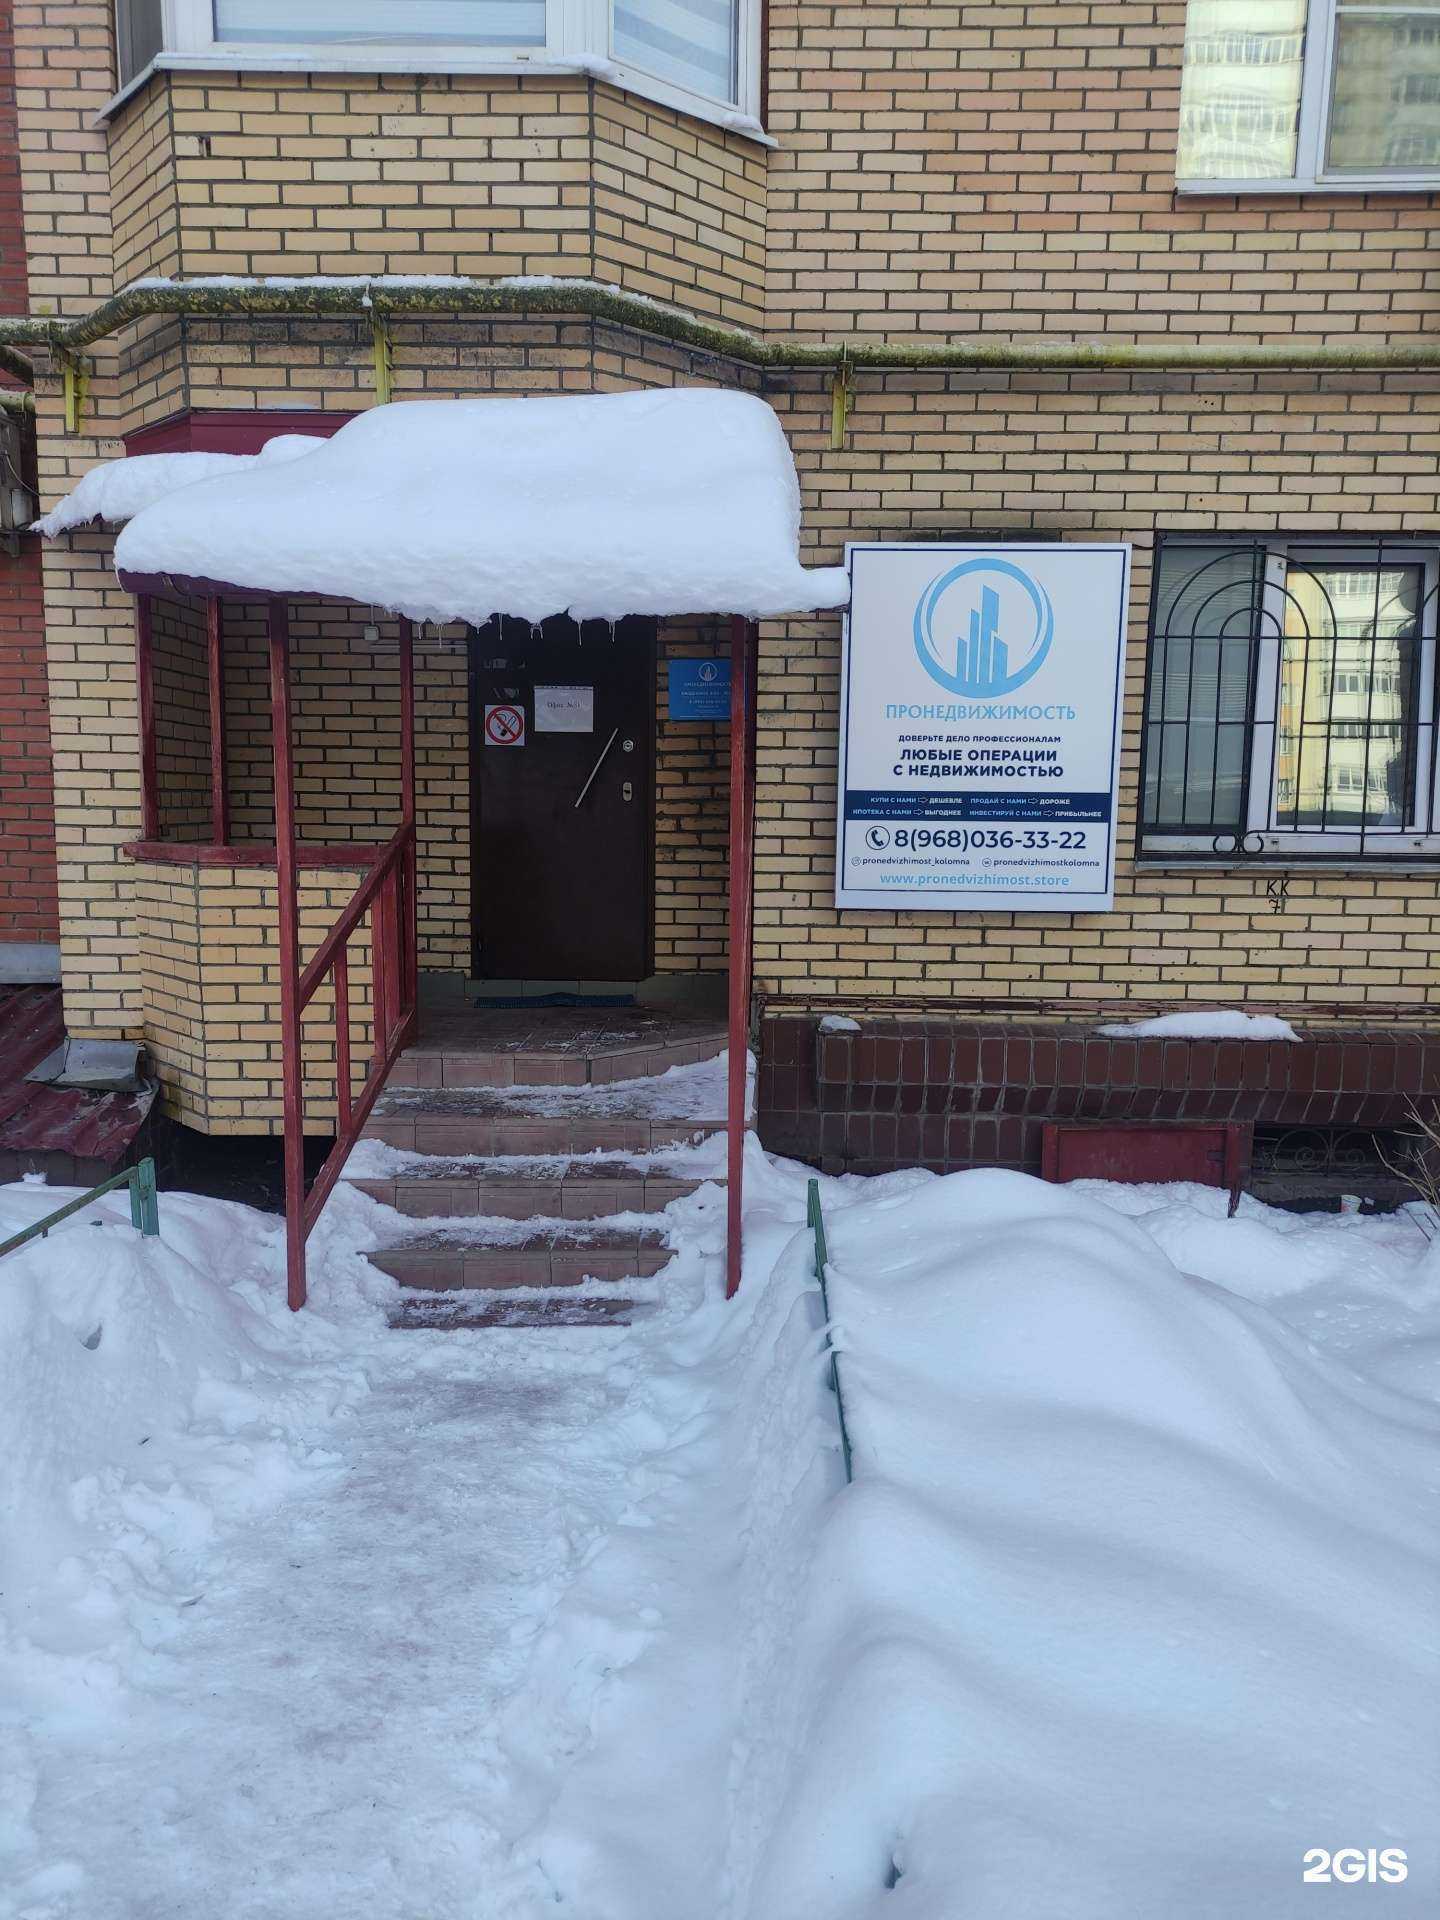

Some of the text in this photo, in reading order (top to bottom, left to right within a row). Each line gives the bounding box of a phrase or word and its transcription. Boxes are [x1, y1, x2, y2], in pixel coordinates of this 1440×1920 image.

[886, 704, 1076, 721] ПРОНЕДВИЖИМОСТЬ
[899, 735, 1062, 743] ДОВЕРЬТЕ ДЕЛО ПРОФЕССИОНАЛАМ
[900, 749, 1057, 763] ЛЮБЫЕ ОПЕРАЦИИ
[893, 765, 1064, 778] С НЕДВИЖИМОСТЬЮ
[1039, 798, 1070, 806] ДОРОЖЕ
[924, 809, 962, 817] ВЫГОДНЕЕ
[894, 829, 1086, 852] 8(968)036-33-22
[862, 856, 970, 867] pronedvizhimost_kolomna
[993, 858, 1100, 867] pronedvizhimostkolomna
[880, 872, 1070, 887] www.pronedvizhimost.store
